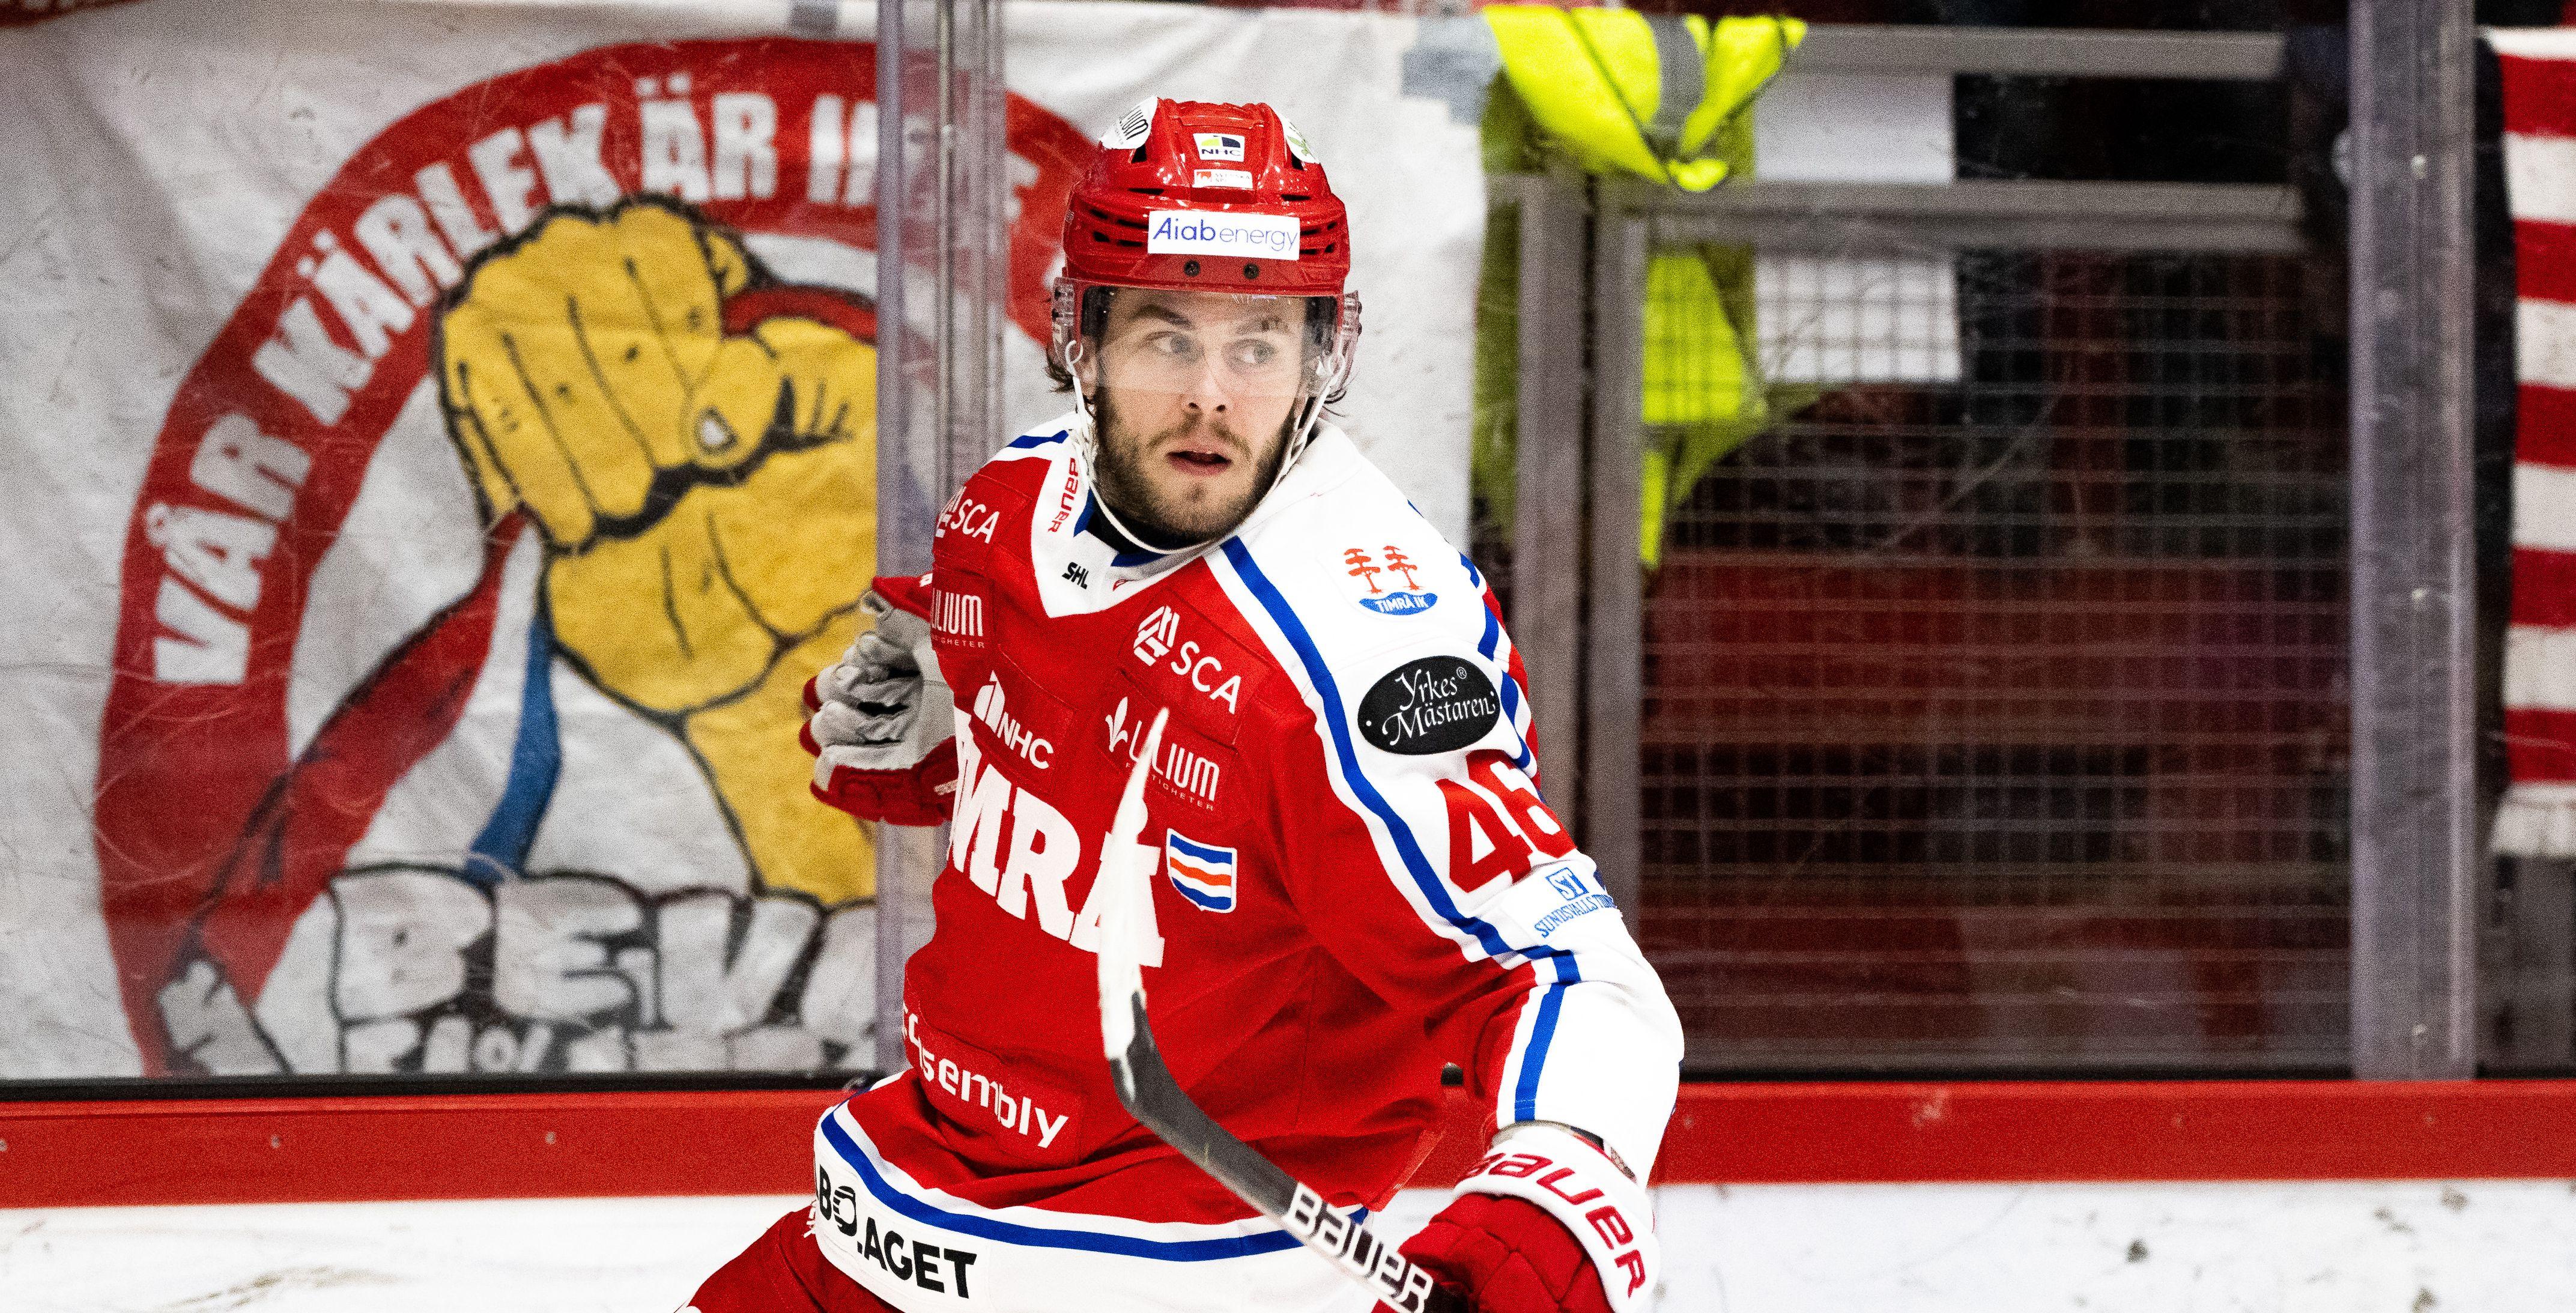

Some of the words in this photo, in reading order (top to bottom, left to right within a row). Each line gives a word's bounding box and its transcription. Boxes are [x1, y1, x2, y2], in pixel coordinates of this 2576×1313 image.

[145, 413, 314, 685] VÅR
[251, 103, 622, 426] KÄRLEK
[633, 71, 778, 202] ÄR
[950, 499, 1000, 544] SCA
[1062, 562, 1089, 590] SHL
[1375, 594, 1415, 613] TIMRÅ
[1413, 596, 1429, 609] IK
[1171, 641, 1241, 715] SCA
[997, 715, 1054, 770] NHC
[1381, 691, 1496, 746] Mästaren
[1129, 720, 1220, 802] LLIUM
[1435, 749, 1578, 894] 46
[1282, 1181, 1434, 1313] BAUER
